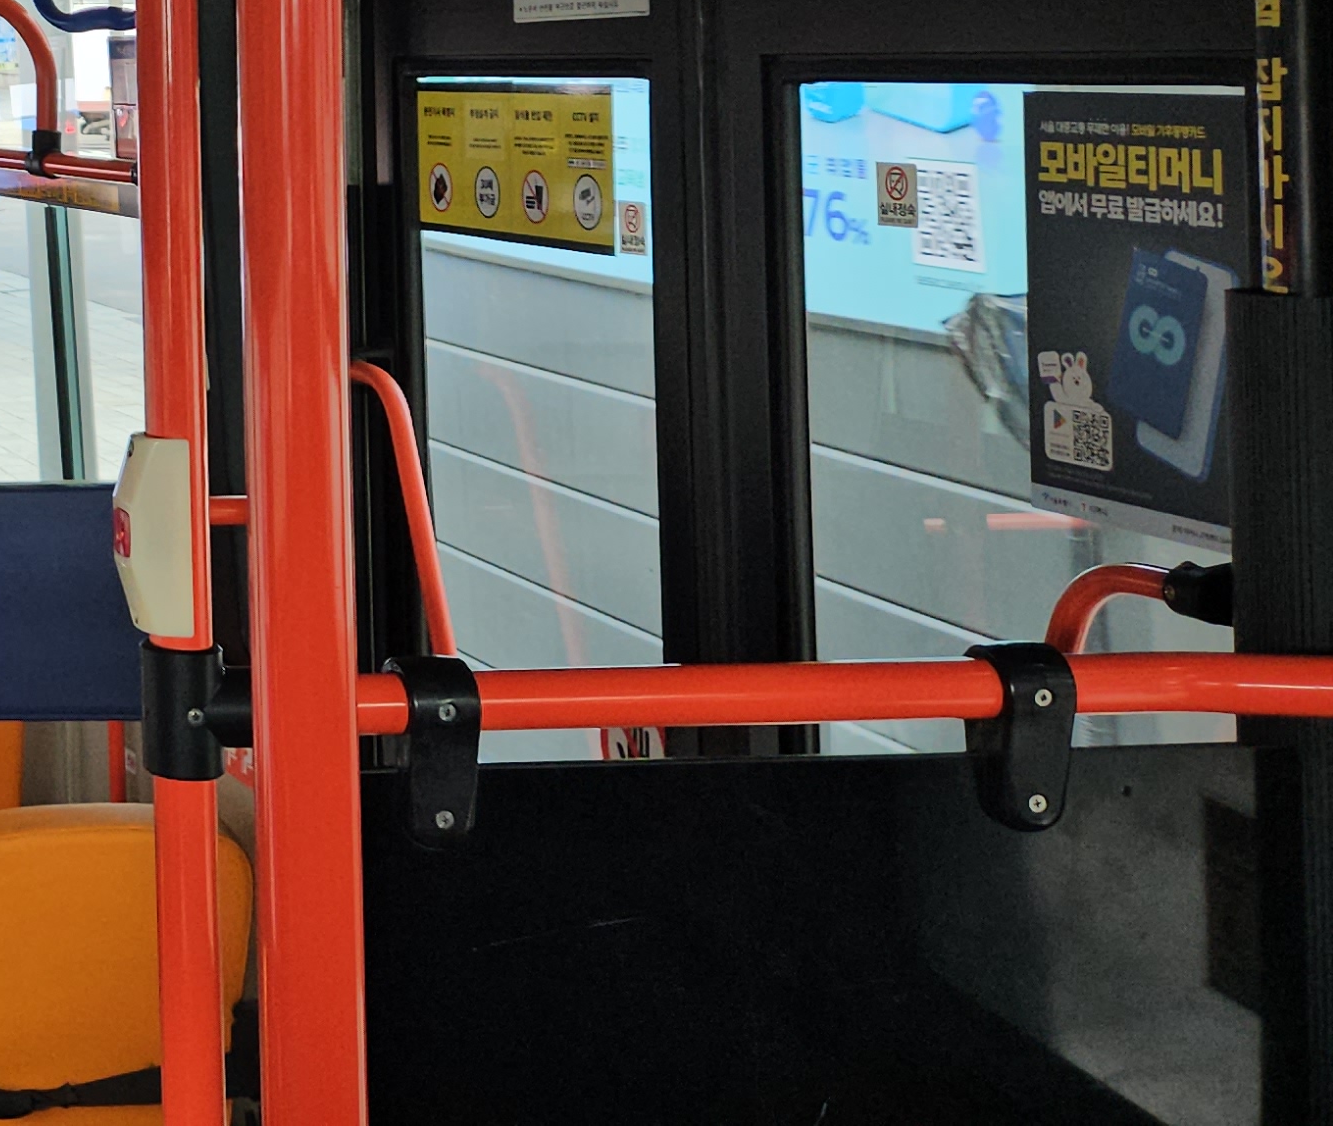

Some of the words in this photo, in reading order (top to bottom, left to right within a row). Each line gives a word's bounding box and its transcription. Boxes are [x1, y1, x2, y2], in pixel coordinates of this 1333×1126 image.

[1038, 141, 1224, 196] 모바일티머니
[1038, 189, 1088, 218] 앱에서
[1090, 194, 1125, 220] 무료
[1126, 195, 1224, 229] 발급하세요!
